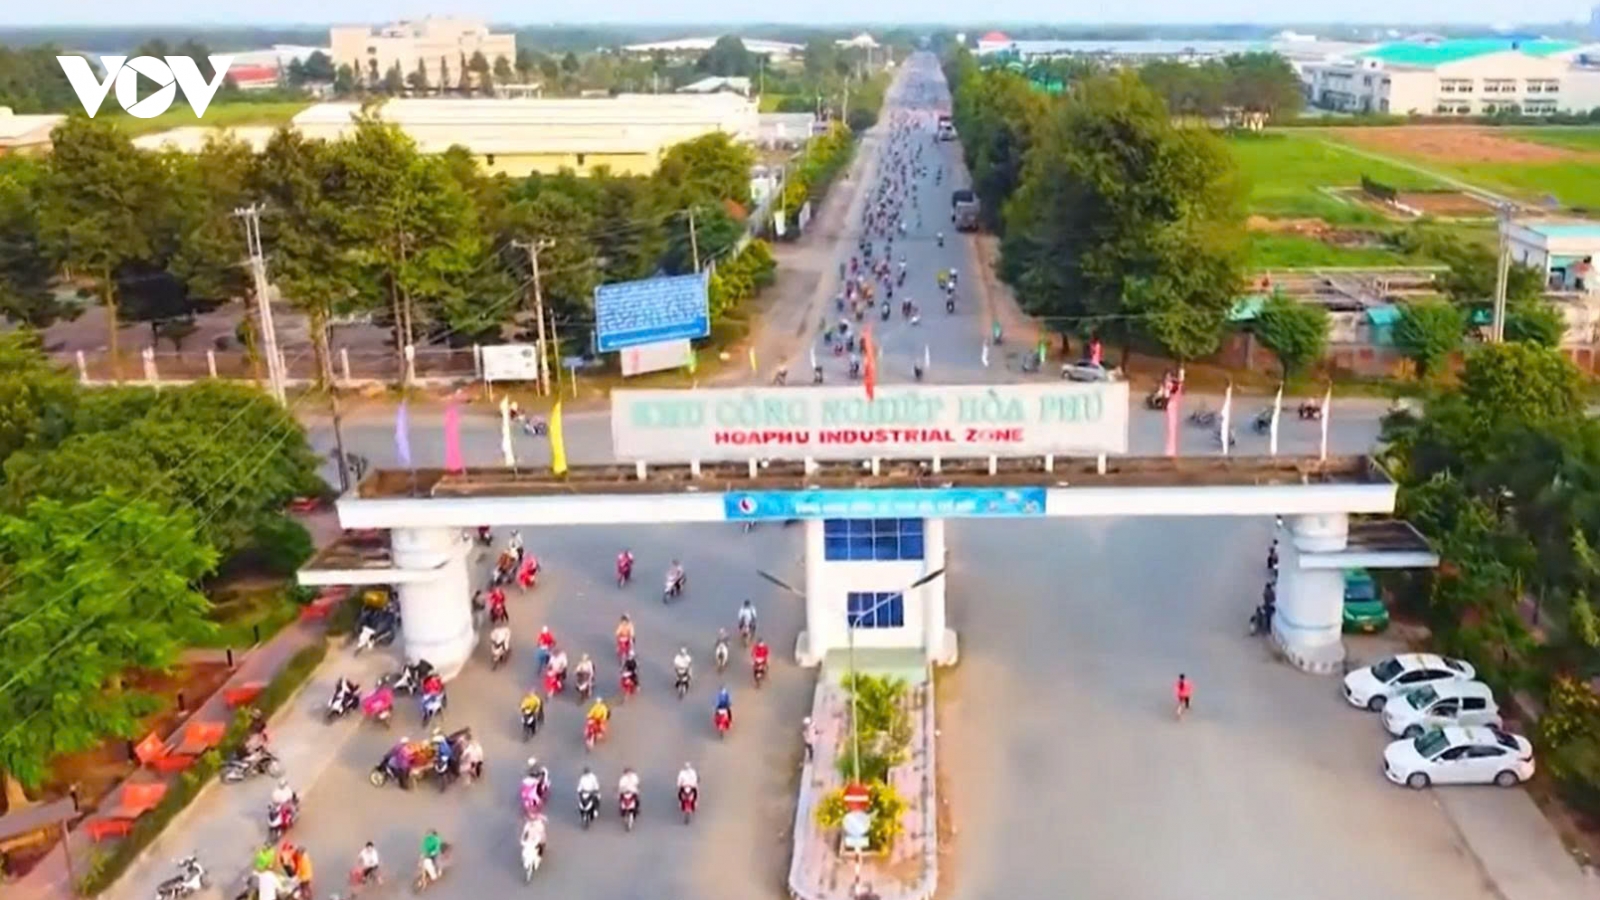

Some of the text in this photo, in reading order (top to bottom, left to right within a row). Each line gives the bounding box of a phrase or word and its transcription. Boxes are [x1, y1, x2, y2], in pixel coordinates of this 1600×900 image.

[957, 388, 1025, 424] HÒA
[714, 428, 1025, 445] HOAPHU INDUSTRIAL ZONE
